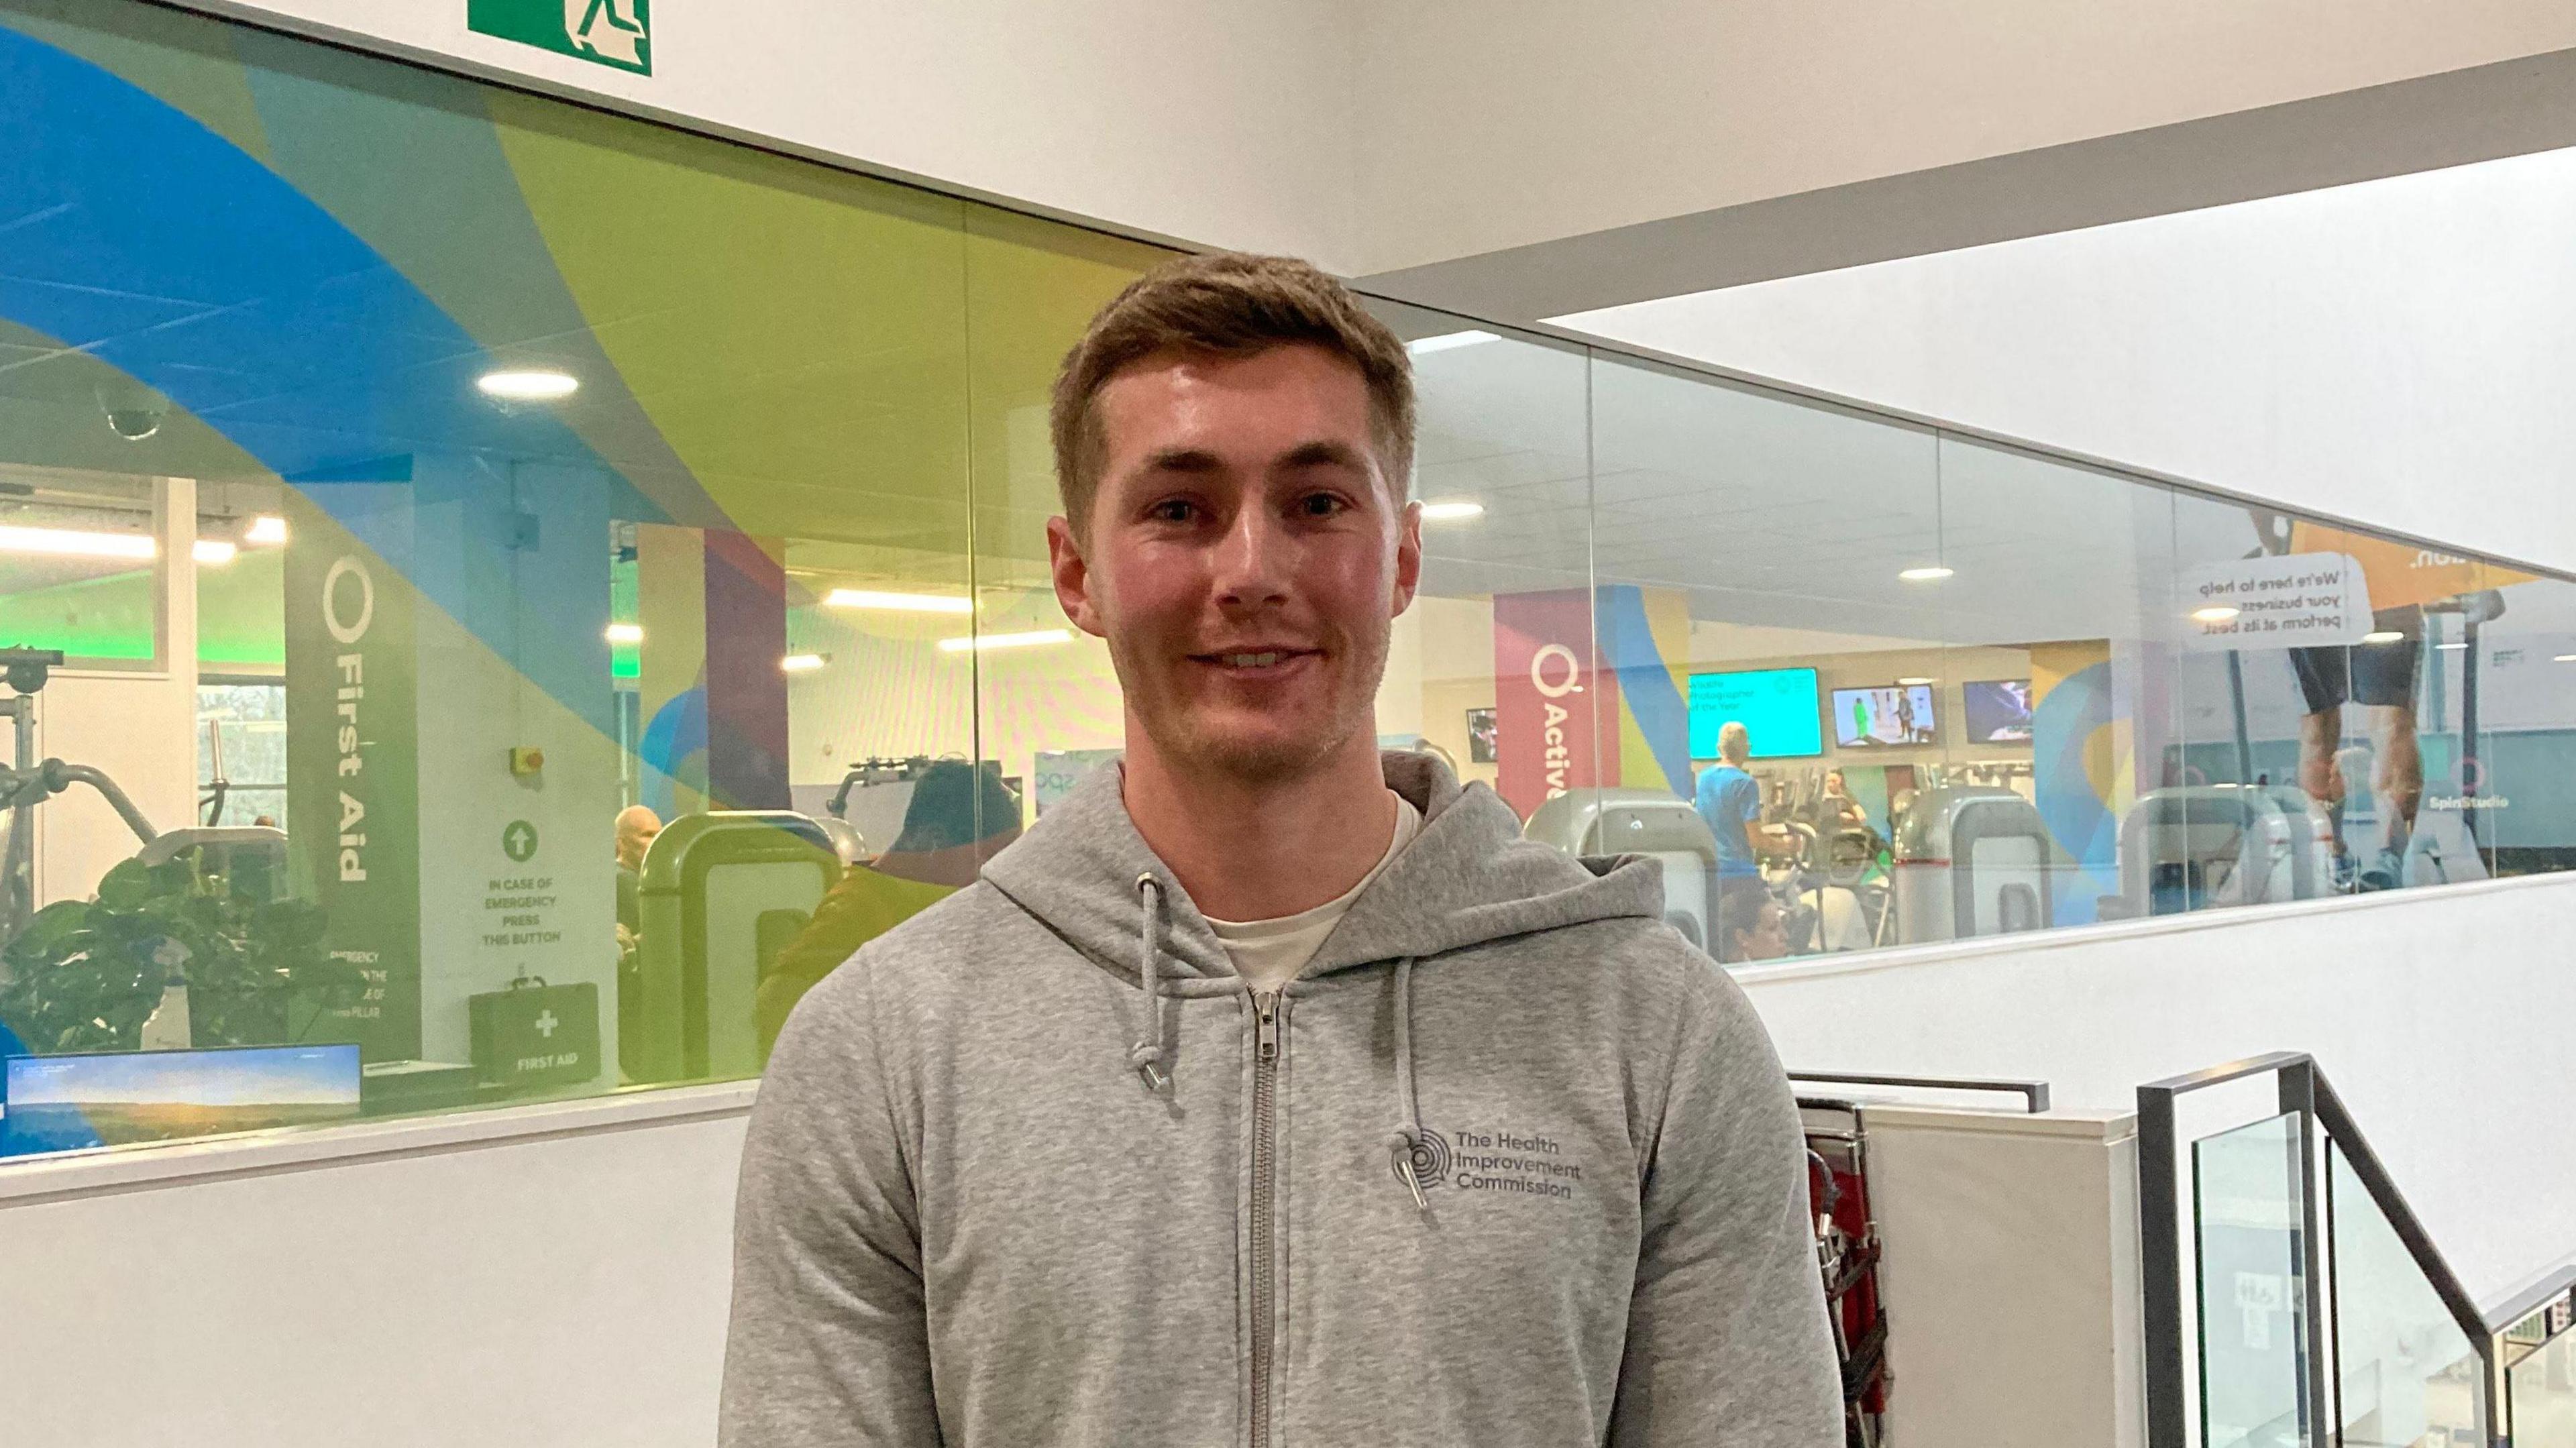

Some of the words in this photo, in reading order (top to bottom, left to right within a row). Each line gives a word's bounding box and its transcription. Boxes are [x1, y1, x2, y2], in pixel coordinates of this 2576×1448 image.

[337, 653, 364, 777] First
[339, 790, 366, 882] Aid
[489, 879, 500, 891] IN
[503, 879, 535, 891] CASE
[537, 877, 553, 889] OF
[485, 896, 557, 909] EMERGENCY
[503, 914, 539, 926] PRESS
[482, 934, 510, 945] THIS
[513, 932, 561, 944] BUTTON
[517, 1055, 553, 1071] FIRST
[557, 1052, 578, 1066] AID
[1456, 1132, 1492, 1148] The
[1497, 1133, 1560, 1155] Health
[1456, 1153, 1580, 1180] Improvement
[1456, 1173, 1572, 1199] Commission
